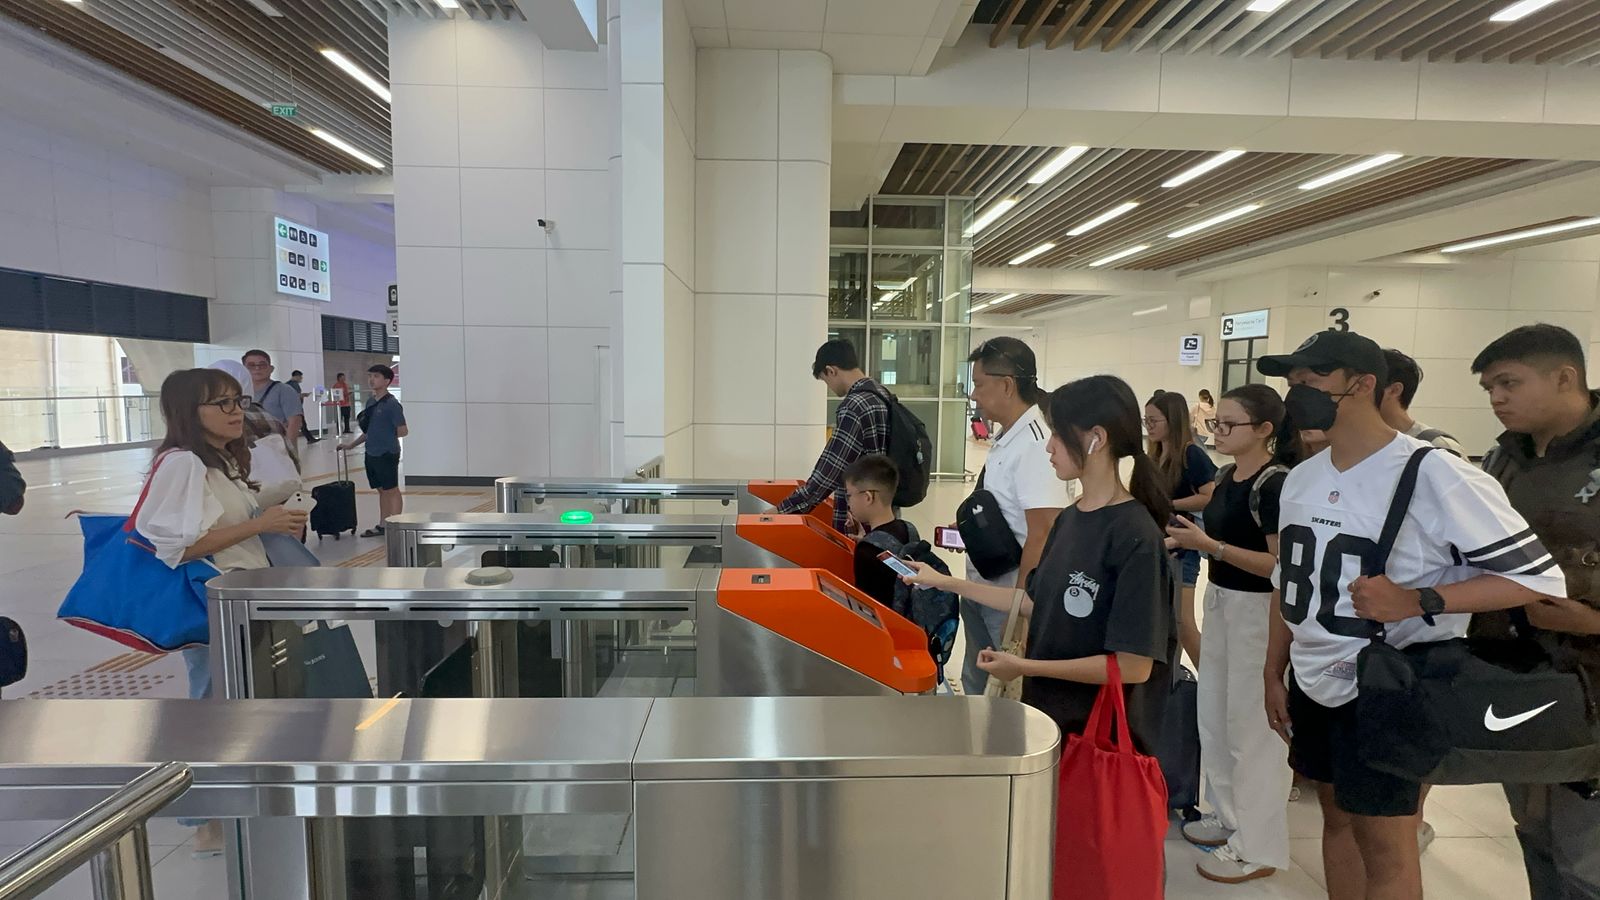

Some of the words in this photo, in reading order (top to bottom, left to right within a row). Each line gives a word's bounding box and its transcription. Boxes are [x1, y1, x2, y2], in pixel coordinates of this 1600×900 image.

[273, 106, 295, 116] EXIT
[392, 320, 398, 332] 5
[1328, 308, 1349, 332] 3
[1311, 516, 1341, 528] SKATERS
[1279, 524, 1382, 639] 80
